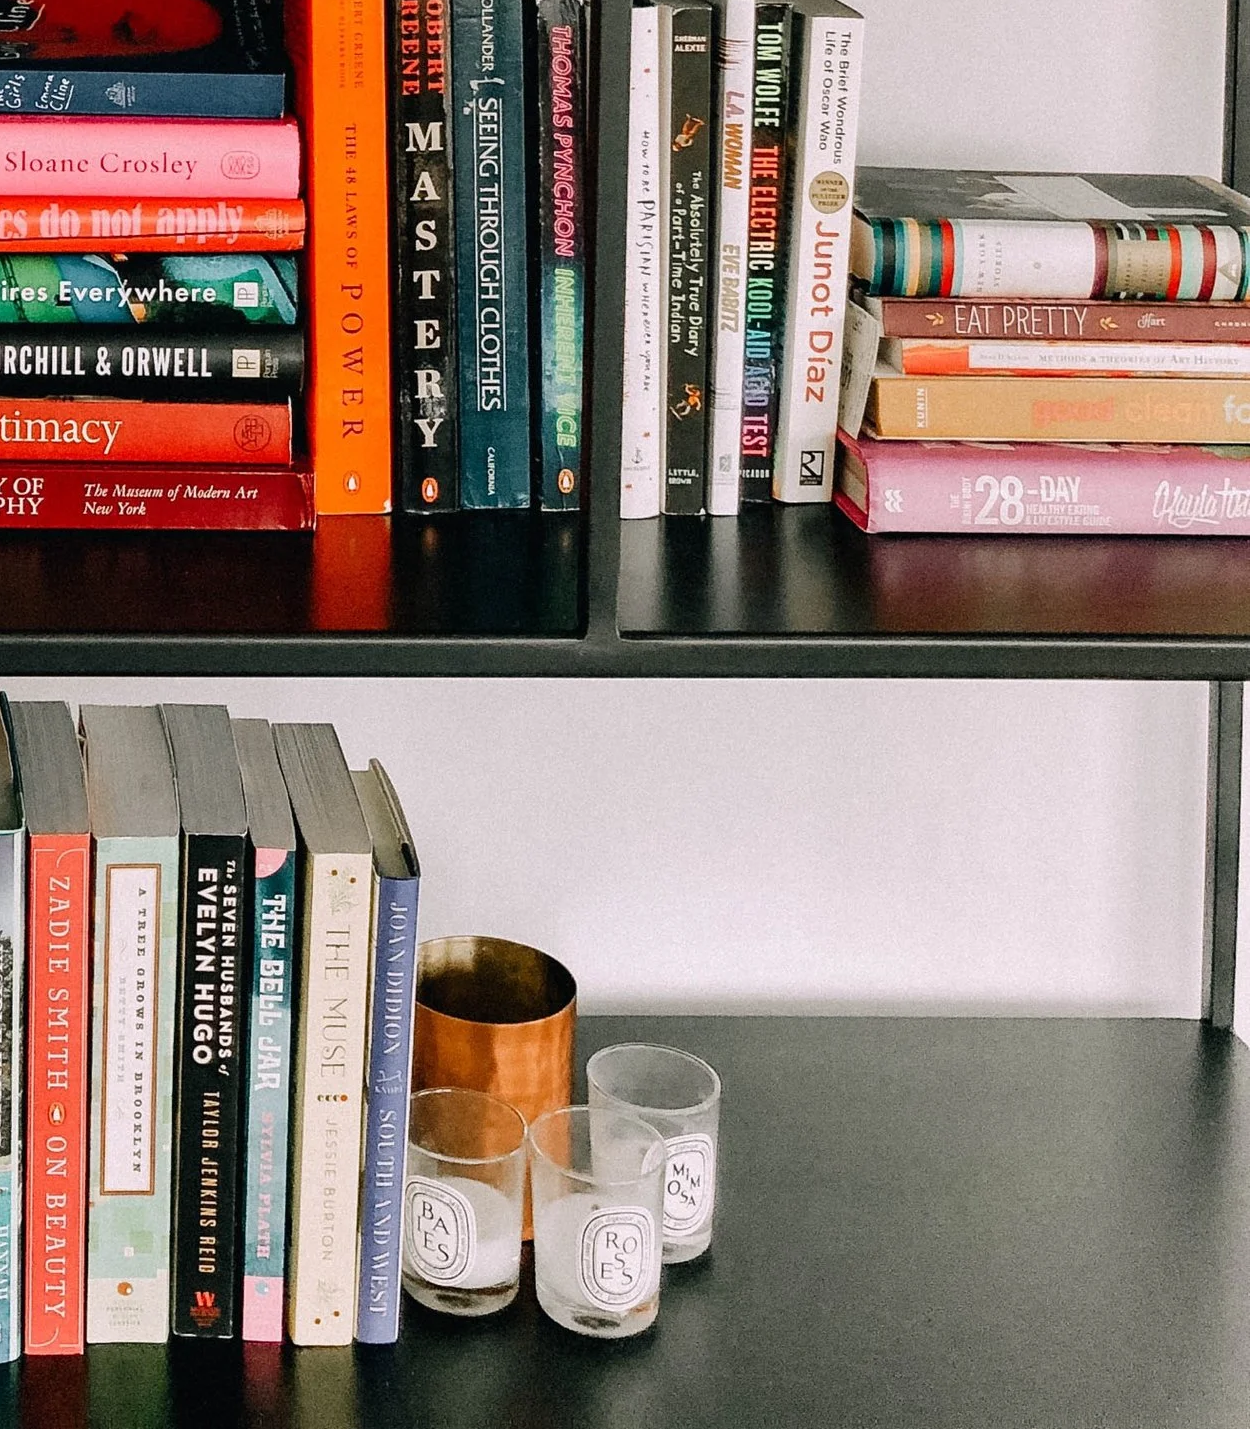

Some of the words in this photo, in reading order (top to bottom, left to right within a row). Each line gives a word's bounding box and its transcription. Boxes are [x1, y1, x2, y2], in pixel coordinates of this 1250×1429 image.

[756, 22, 783, 62] TOM
[823, 59, 834, 73] of
[824, 31, 836, 57] Life
[550, 24, 574, 129] THOMAS
[754, 69, 781, 128] WOLFE
[821, 77, 833, 116] Oscar
[344, 123, 357, 160] THE
[477, 97, 499, 178] SEEING
[818, 119, 831, 151] Wao
[5, 150, 90, 174] Sloane
[100, 151, 199, 181] Crosley
[346, 166, 357, 184] 48
[552, 132, 575, 258] PYNCHON
[39, 203, 87, 240] do
[103, 204, 144, 241] not
[156, 201, 245, 246] apply
[345, 188, 358, 241] LAWS
[478, 183, 500, 301] THROUGH
[346, 246, 359, 269] OF
[404, 121, 445, 449] MASTERY
[810, 220, 840, 317] Junot
[59, 279, 218, 304] Everywhere
[954, 305, 994, 335] EAT
[1002, 305, 1088, 336] PRETTY
[1137, 312, 1166, 329] Hart
[554, 268, 576, 386] INHERENT
[95, 348, 112, 377] &
[121, 347, 214, 379] ORWELL
[340, 283, 364, 439] POWER
[480, 307, 502, 412] CLOTHES
[805, 330, 834, 403] Díaz
[556, 389, 577, 449] VICE
[12, 477, 46, 498] OF
[82, 501, 111, 517] New
[114, 502, 147, 517] York
[48, 875, 70, 974] ZADIE
[194, 867, 218, 973] EVELYN
[260, 893, 287, 949] THE
[386, 901, 408, 963] JOAN
[324, 923, 351, 981] THE
[258, 958, 285, 1027] BELL
[383, 972, 404, 1055] DIDION
[46, 988, 69, 1090] SMITH
[192, 982, 215, 1065] HUGO
[320, 996, 349, 1078] MUSE
[253, 1036, 282, 1091] JAR
[201, 1091, 221, 1150] TAYLOR
[324, 1118, 339, 1178] JESSIE
[375, 1109, 398, 1188] SOUTH
[45, 1135, 67, 1177] ON
[199, 1157, 219, 1228] JENKINS
[371, 1198, 393, 1246] AND
[321, 1187, 336, 1262] BURTON
[44, 1192, 67, 1319] BEAUTY
[198, 1236, 217, 1273] REID
[368, 1252, 391, 1317] WEST
